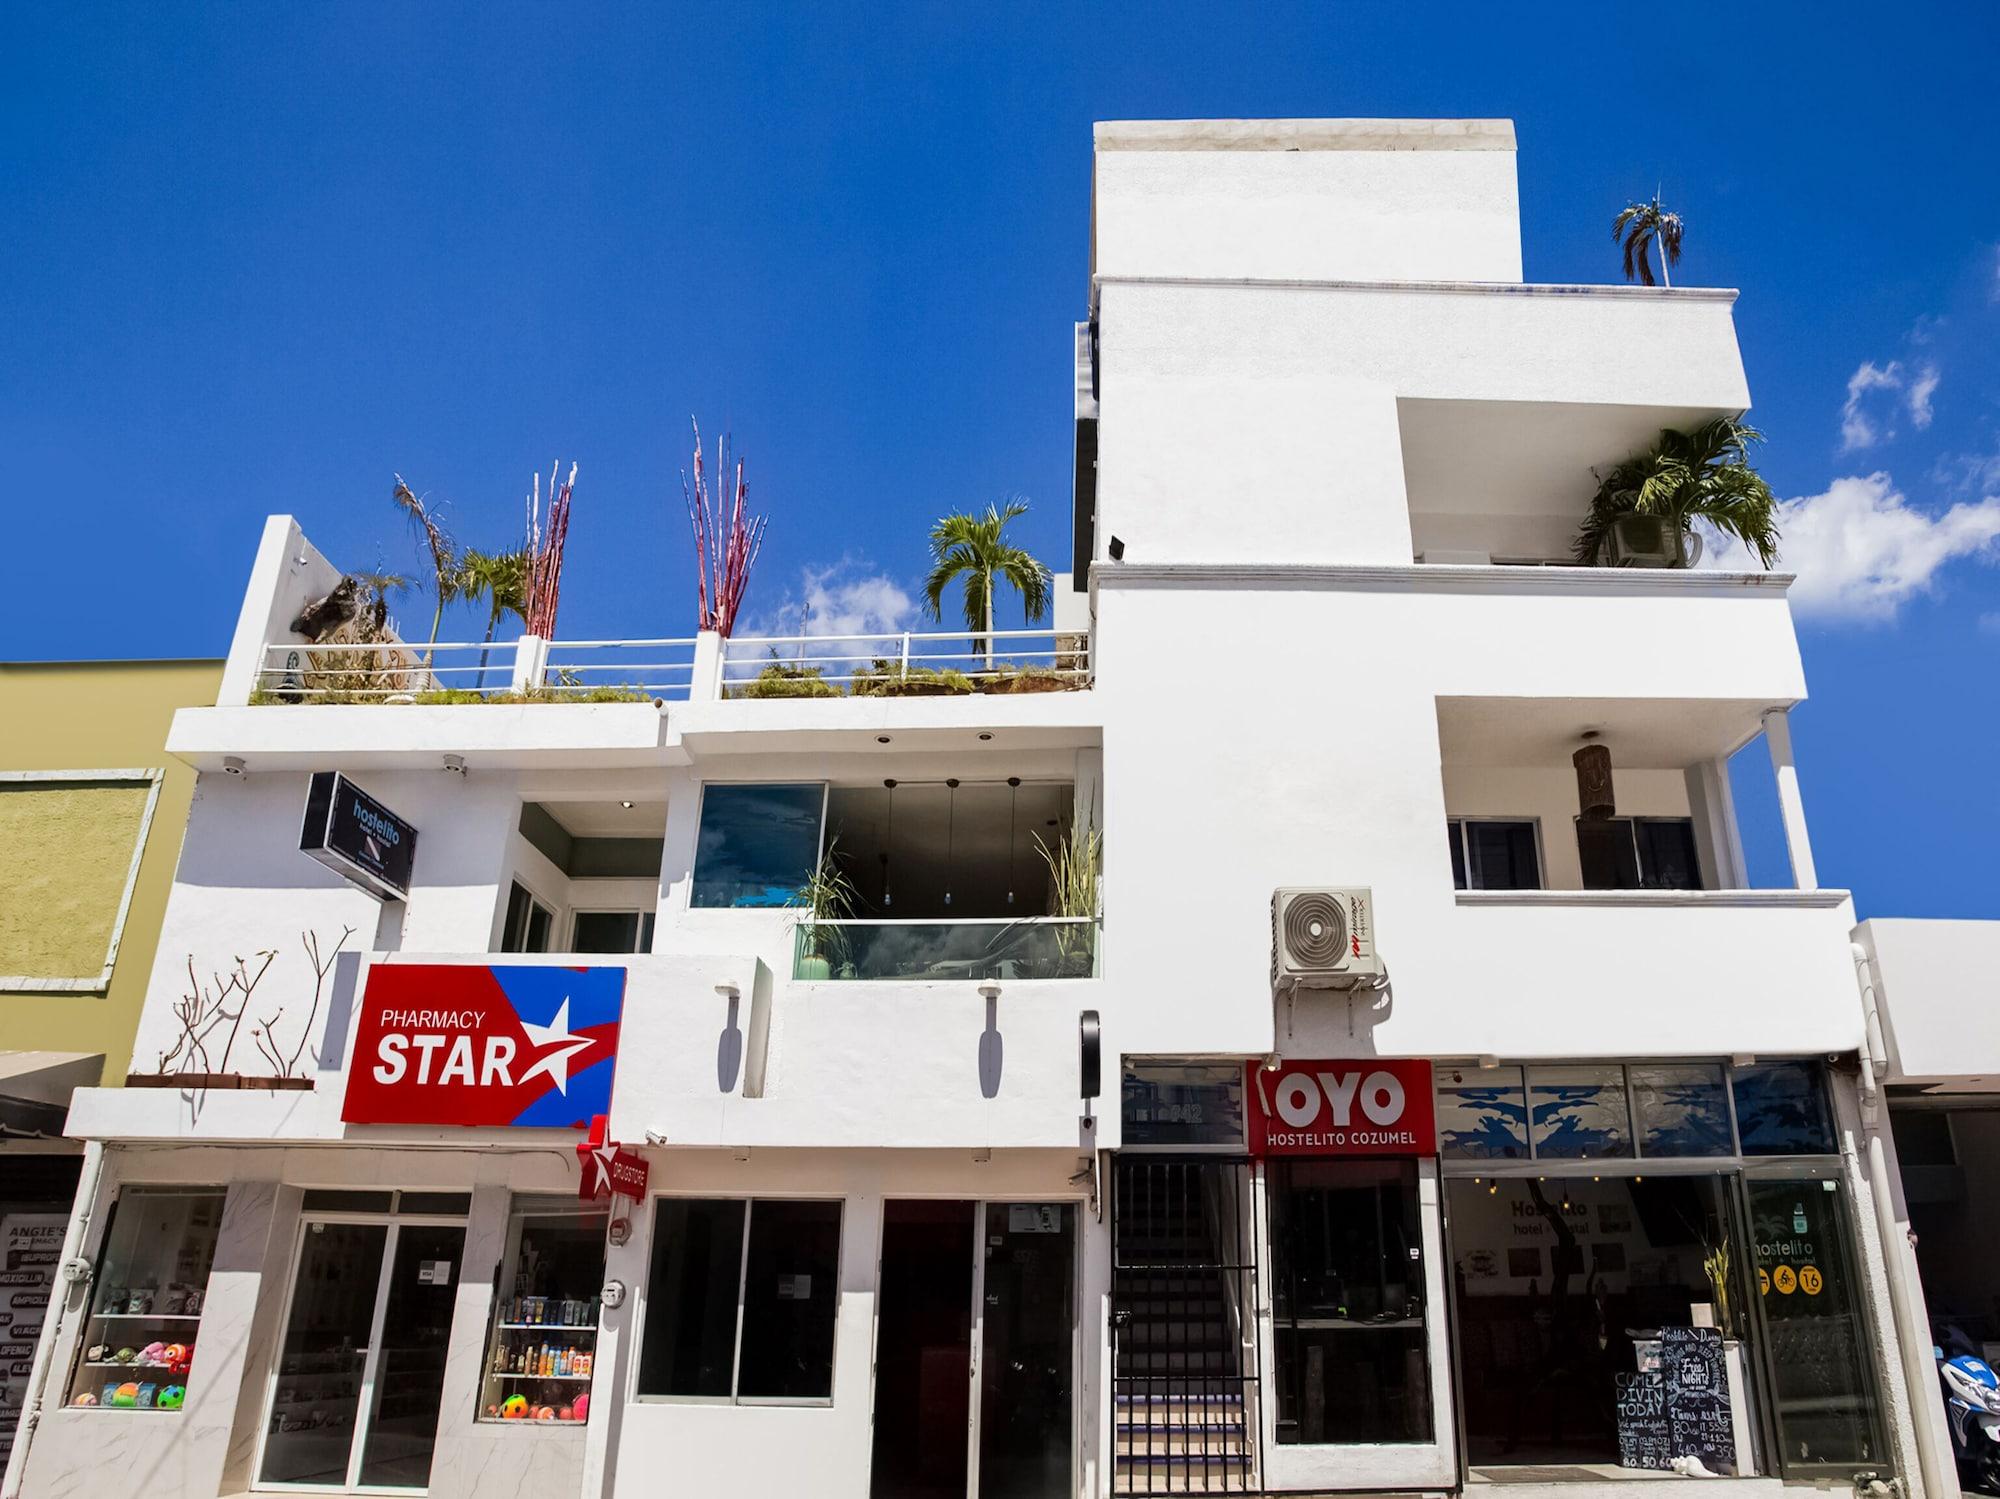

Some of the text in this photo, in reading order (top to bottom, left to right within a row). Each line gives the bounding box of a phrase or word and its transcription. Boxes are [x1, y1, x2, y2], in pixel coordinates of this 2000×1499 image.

[353, 799, 400, 845] hostelito
[380, 1009, 485, 1029] PHARMACY
[373, 1033, 517, 1087] STAR
[1275, 1071, 1405, 1127] OYO
[1268, 1131, 1416, 1146] HOSTELITO COZUMEL
[613, 1162, 645, 1186] DRUGSTORE
[9, 1226, 68, 1237] ANGIE'S
[1514, 1223, 1543, 1235] hotel
[1803, 1273, 1819, 1288] 16
[1681, 1372, 1709, 1385] NIGHTS
[1617, 1402, 1663, 1417] TODAY
[1623, 1457, 1637, 1467] 80
[1643, 1456, 1657, 1468] 50
